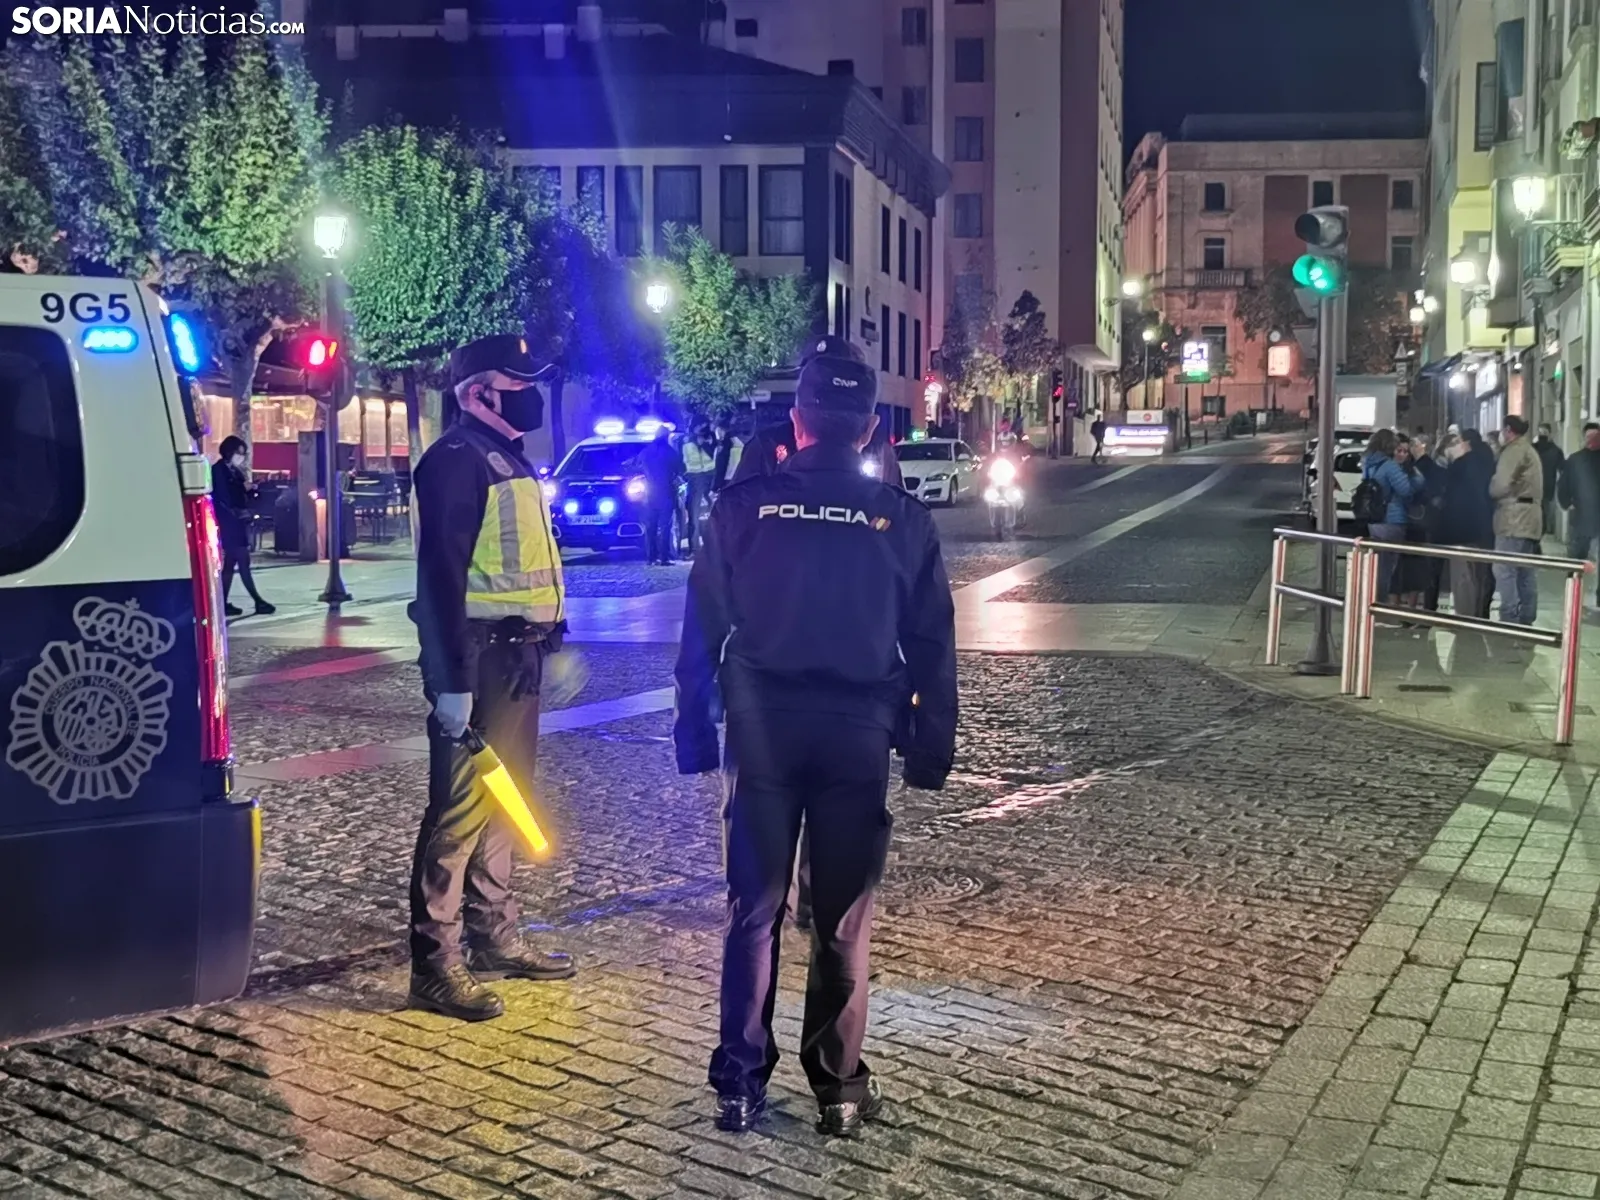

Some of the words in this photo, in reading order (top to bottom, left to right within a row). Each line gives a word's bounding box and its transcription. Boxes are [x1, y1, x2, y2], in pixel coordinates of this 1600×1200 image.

[40, 293, 131, 323] 9G5
[832, 377, 858, 388] CNP
[758, 504, 869, 525] POLICIA
[90, 675, 139, 716] NACIONAL
